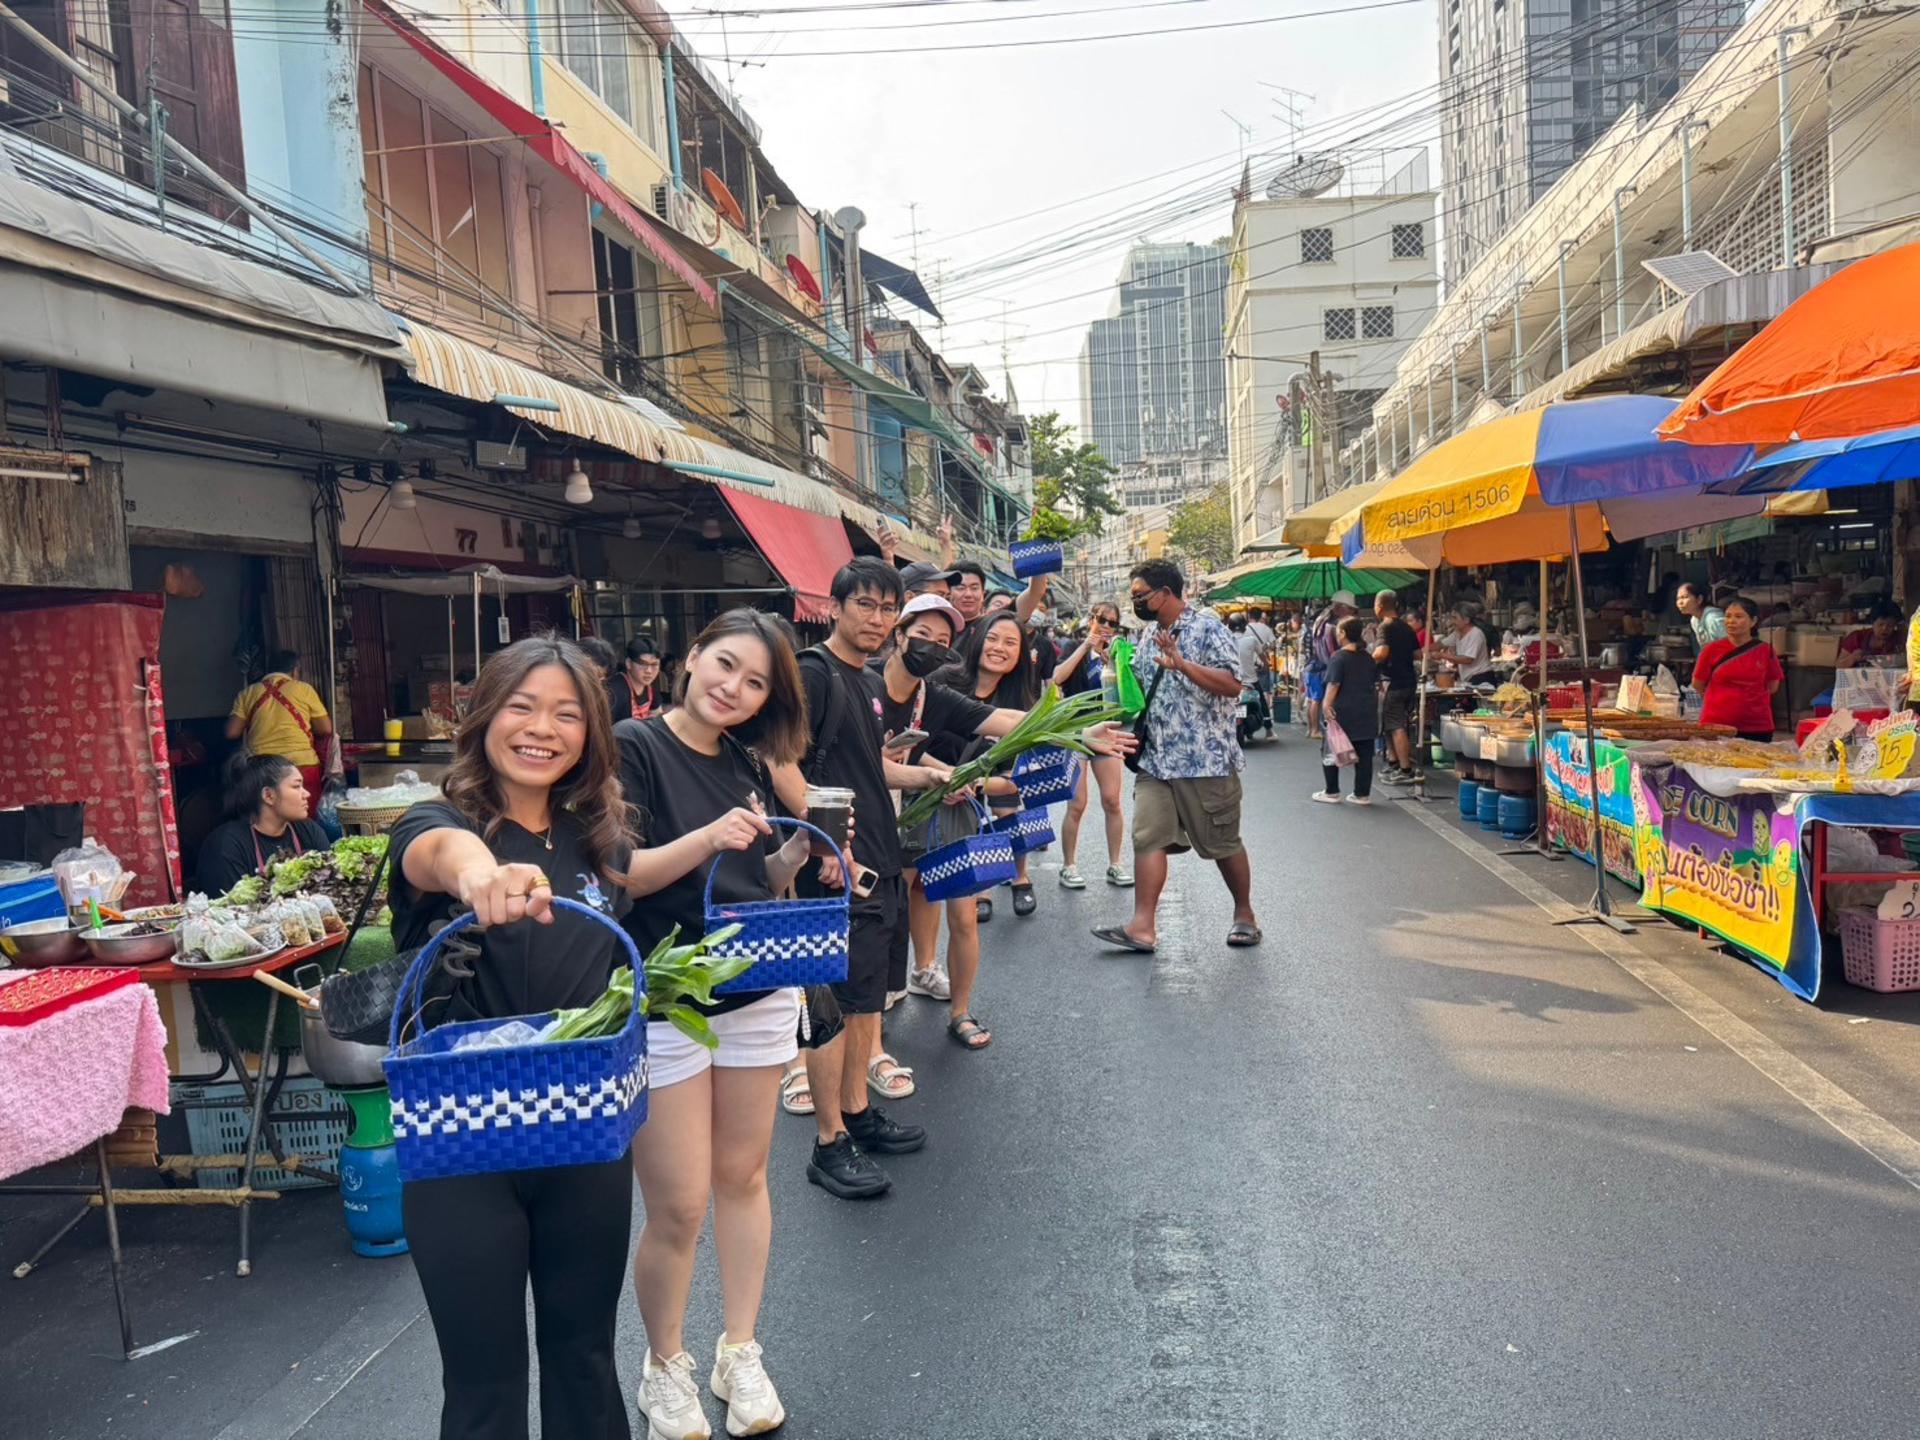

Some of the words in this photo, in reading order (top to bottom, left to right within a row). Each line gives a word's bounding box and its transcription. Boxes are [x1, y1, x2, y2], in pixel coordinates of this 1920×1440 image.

[1387, 499, 1456, 528] สายด่วน
[1464, 484, 1511, 510] 1506
[455, 526, 478, 553] 77
[1686, 790, 1739, 837] CORN
